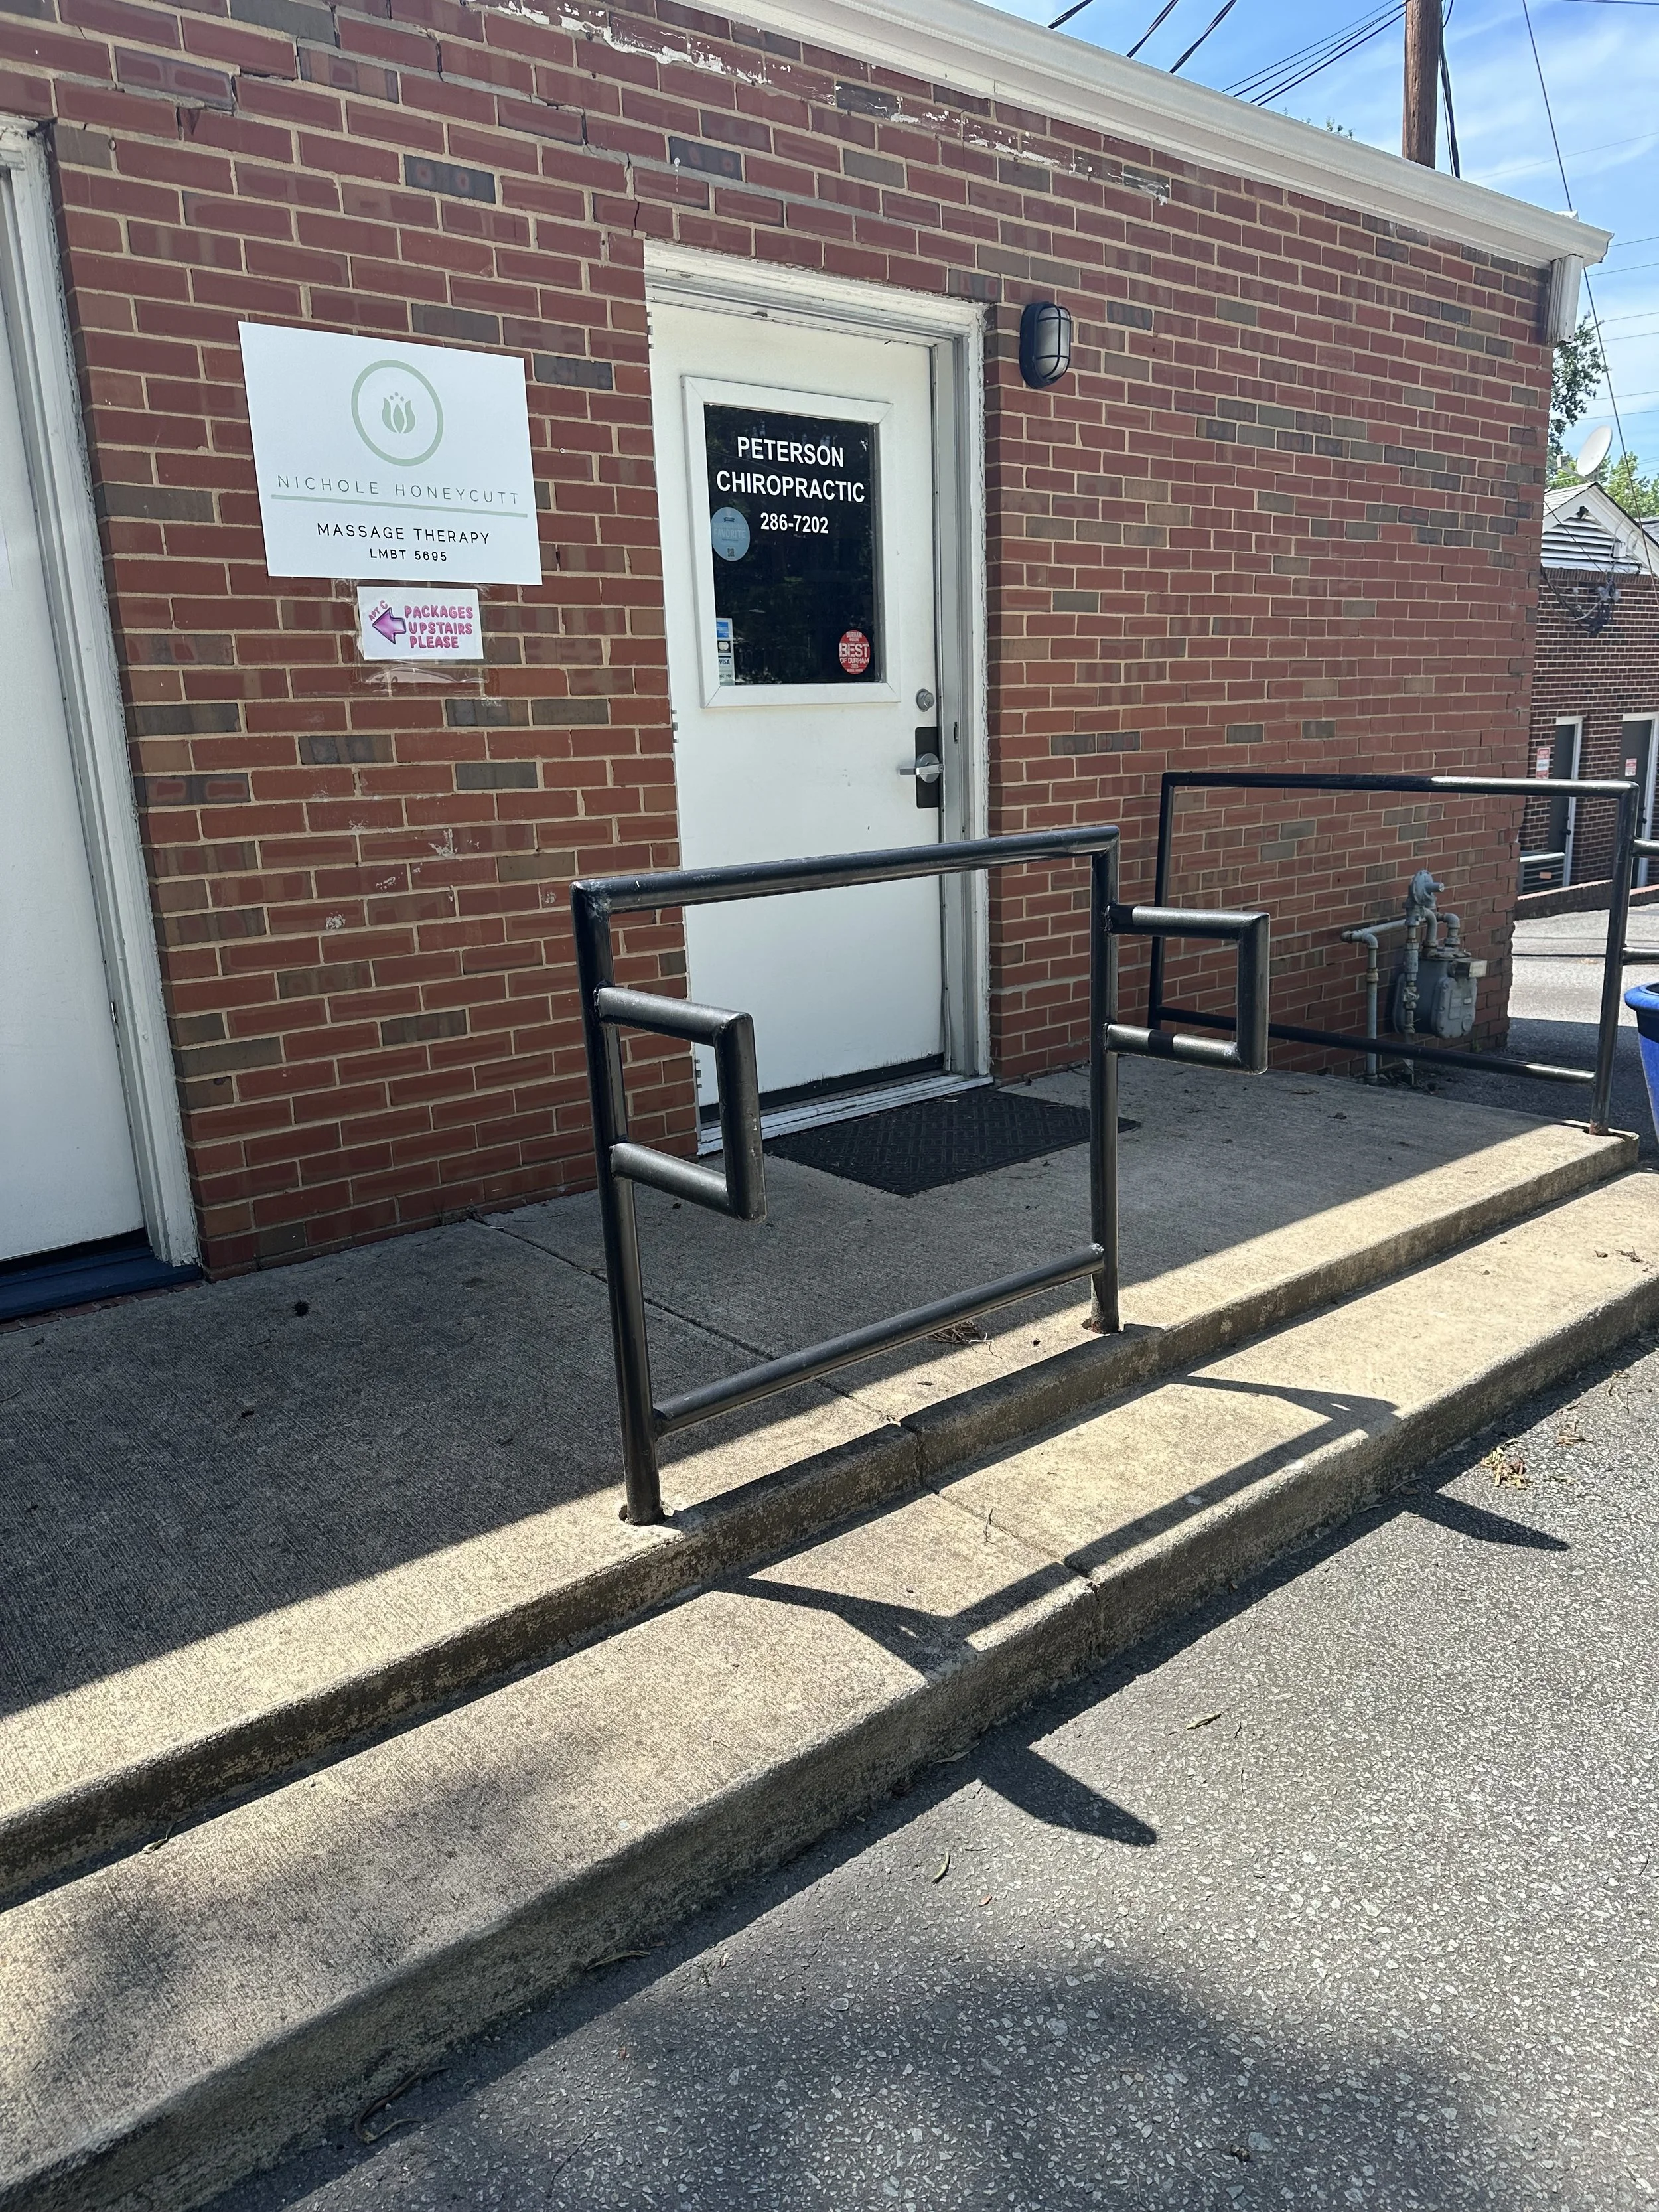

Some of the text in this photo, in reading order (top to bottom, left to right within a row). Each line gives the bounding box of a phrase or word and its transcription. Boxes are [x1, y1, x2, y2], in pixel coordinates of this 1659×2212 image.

[737, 436, 844, 468] PETERSON
[277, 475, 518, 505] NICHOLE HONEYCUTT
[716, 470, 865, 503] CHIROPRACTIC
[760, 512, 829, 534] 286-7202
[317, 523, 490, 544] MASSAGE THERAPY
[713, 528, 746, 539] FAVORITE
[370, 548, 447, 562] LMBT 5695
[368, 599, 388, 621] APT C
[404, 605, 473, 619] PACKAGES
[408, 621, 473, 635] UPSTAIRS
[409, 635, 459, 648] PLEASE
[839, 642, 870, 658] BEST
